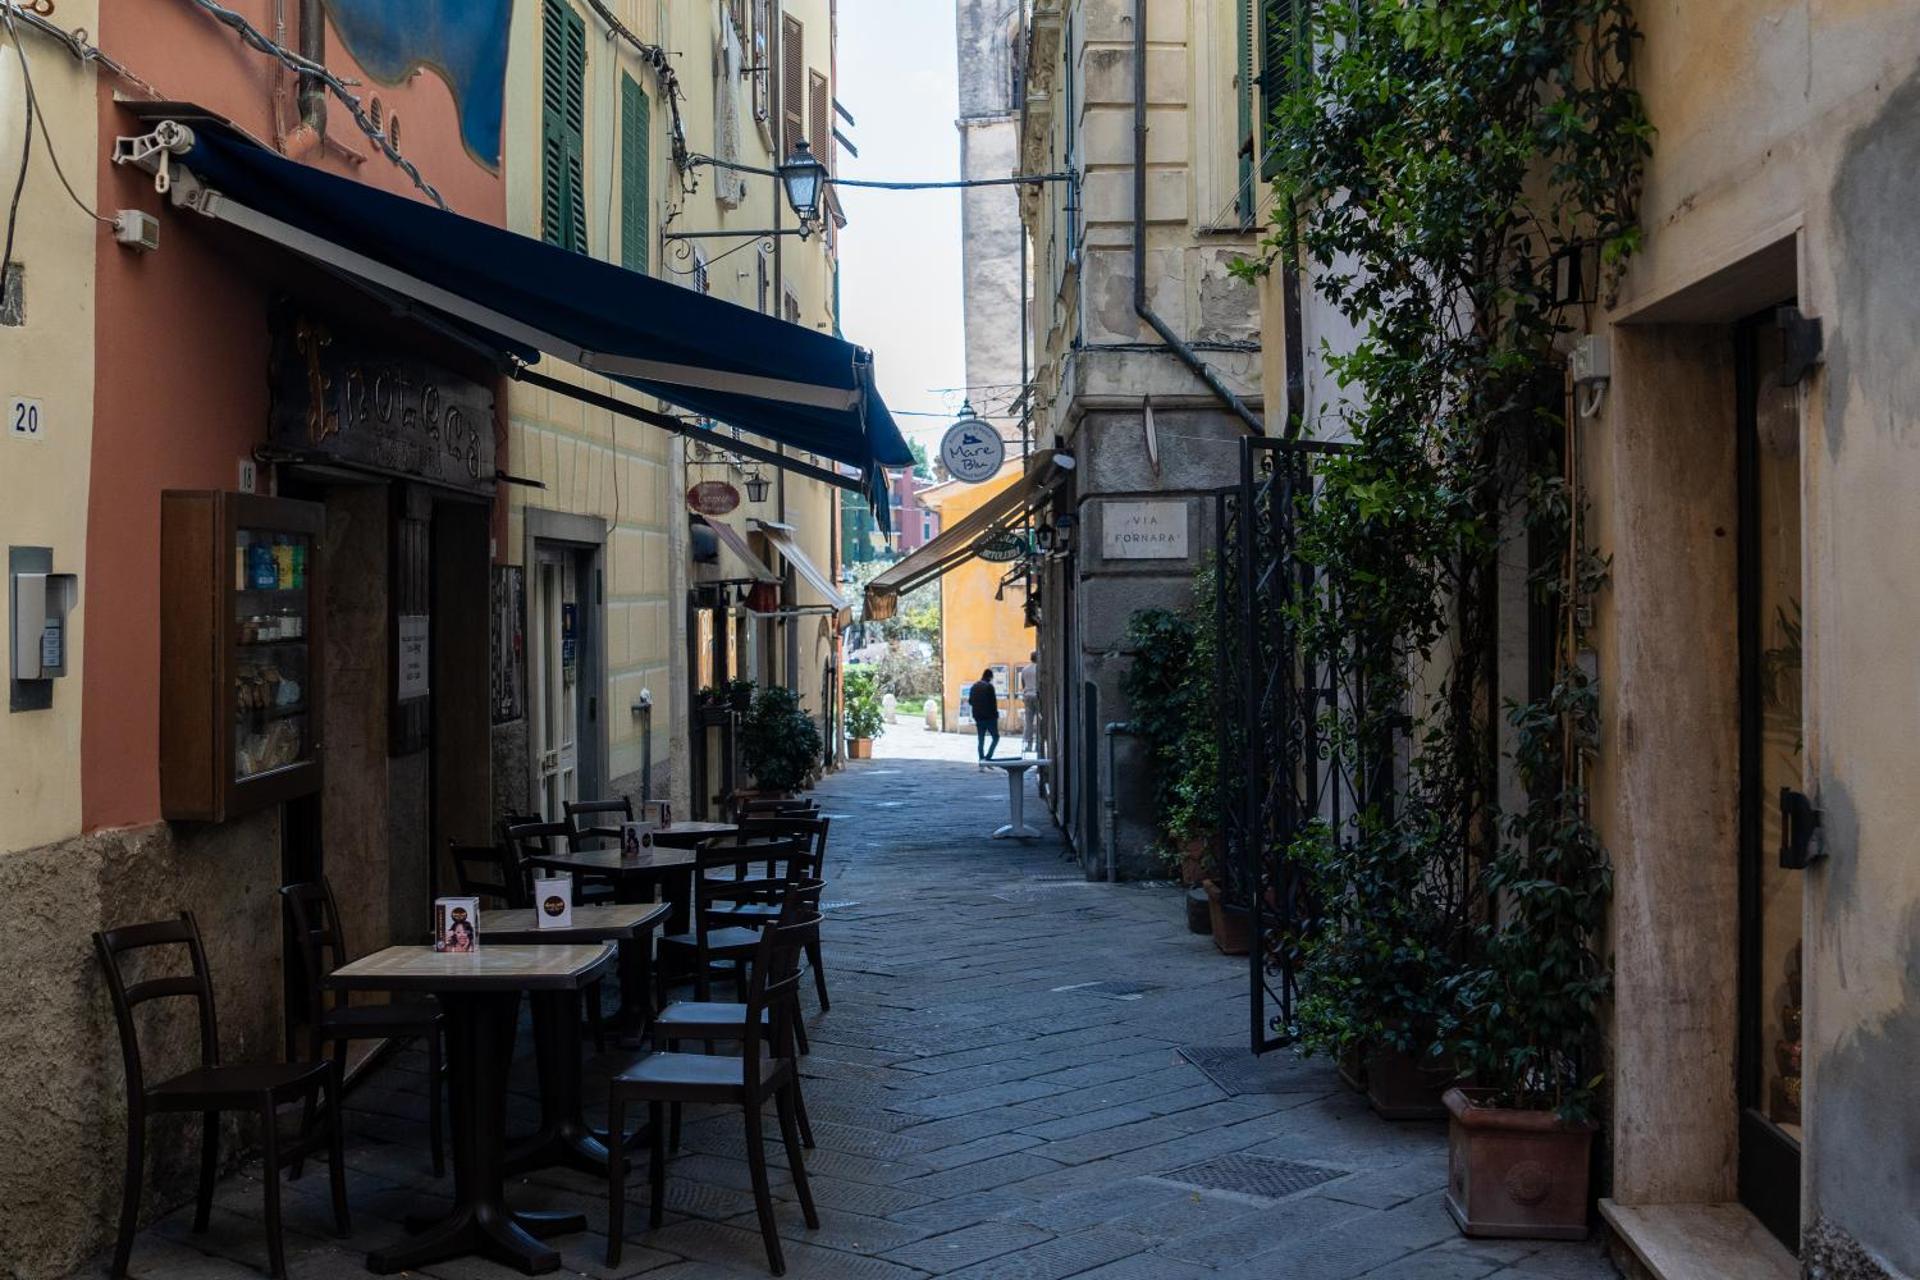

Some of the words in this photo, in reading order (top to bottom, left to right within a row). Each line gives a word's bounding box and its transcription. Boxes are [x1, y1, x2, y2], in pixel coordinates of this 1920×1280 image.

[15, 402, 38, 433] 20
[949, 445, 995, 459] Mare
[961, 458, 988, 471] Blu
[243, 464, 252, 489] 18
[1132, 516, 1158, 526] VIA
[1114, 533, 1176, 544] FORNARA
